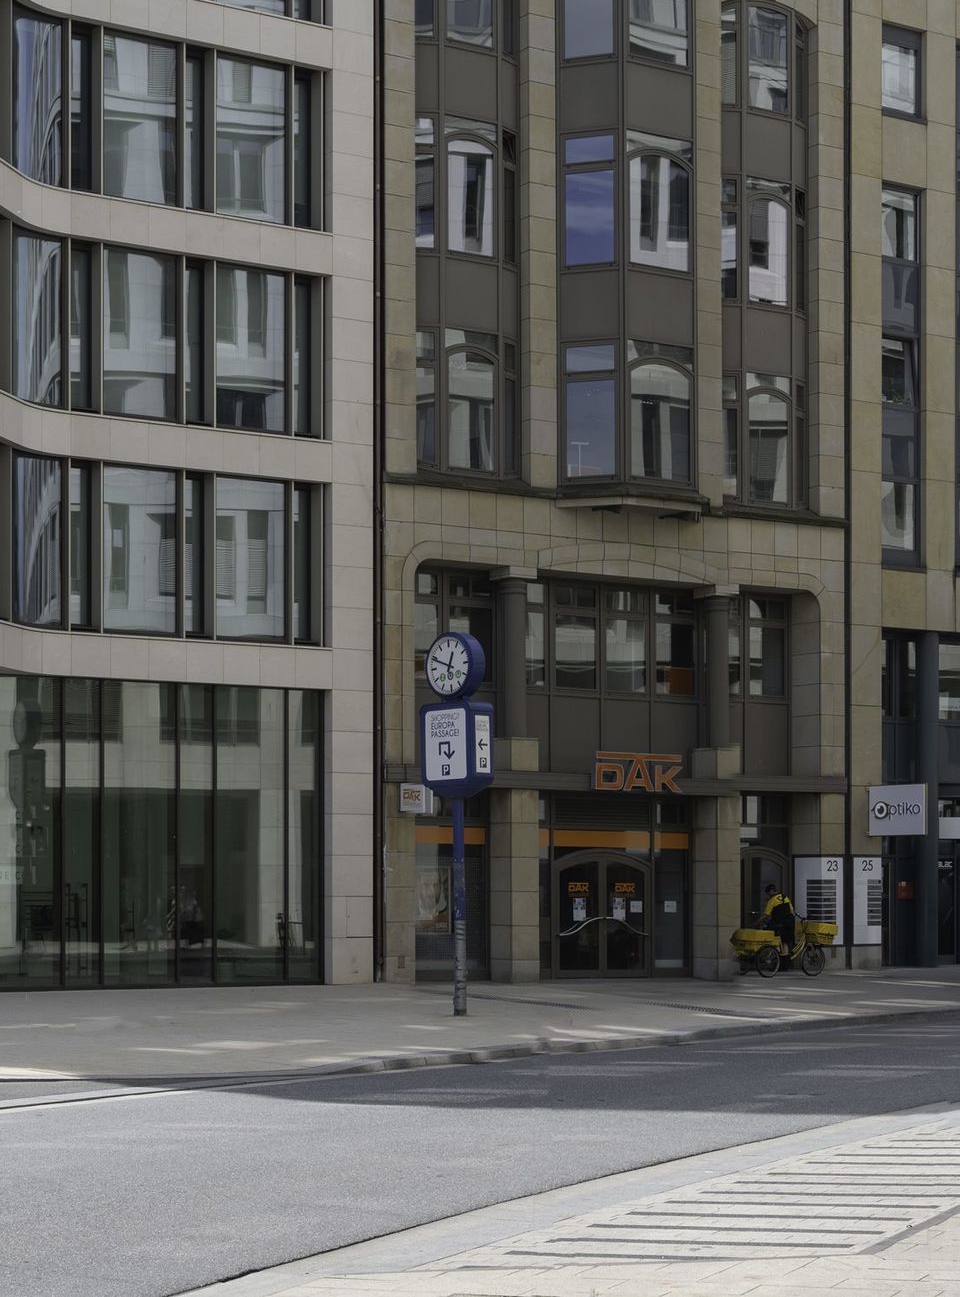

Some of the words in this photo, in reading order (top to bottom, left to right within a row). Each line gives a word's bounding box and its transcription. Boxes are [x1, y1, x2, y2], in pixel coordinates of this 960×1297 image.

[431, 721, 455, 730] EUROPA
[595, 750, 683, 793] DAK
[826, 860, 839, 872] 23
[862, 860, 874, 871] 25
[568, 882, 589, 892] DAK
[614, 882, 636, 893] DAK
